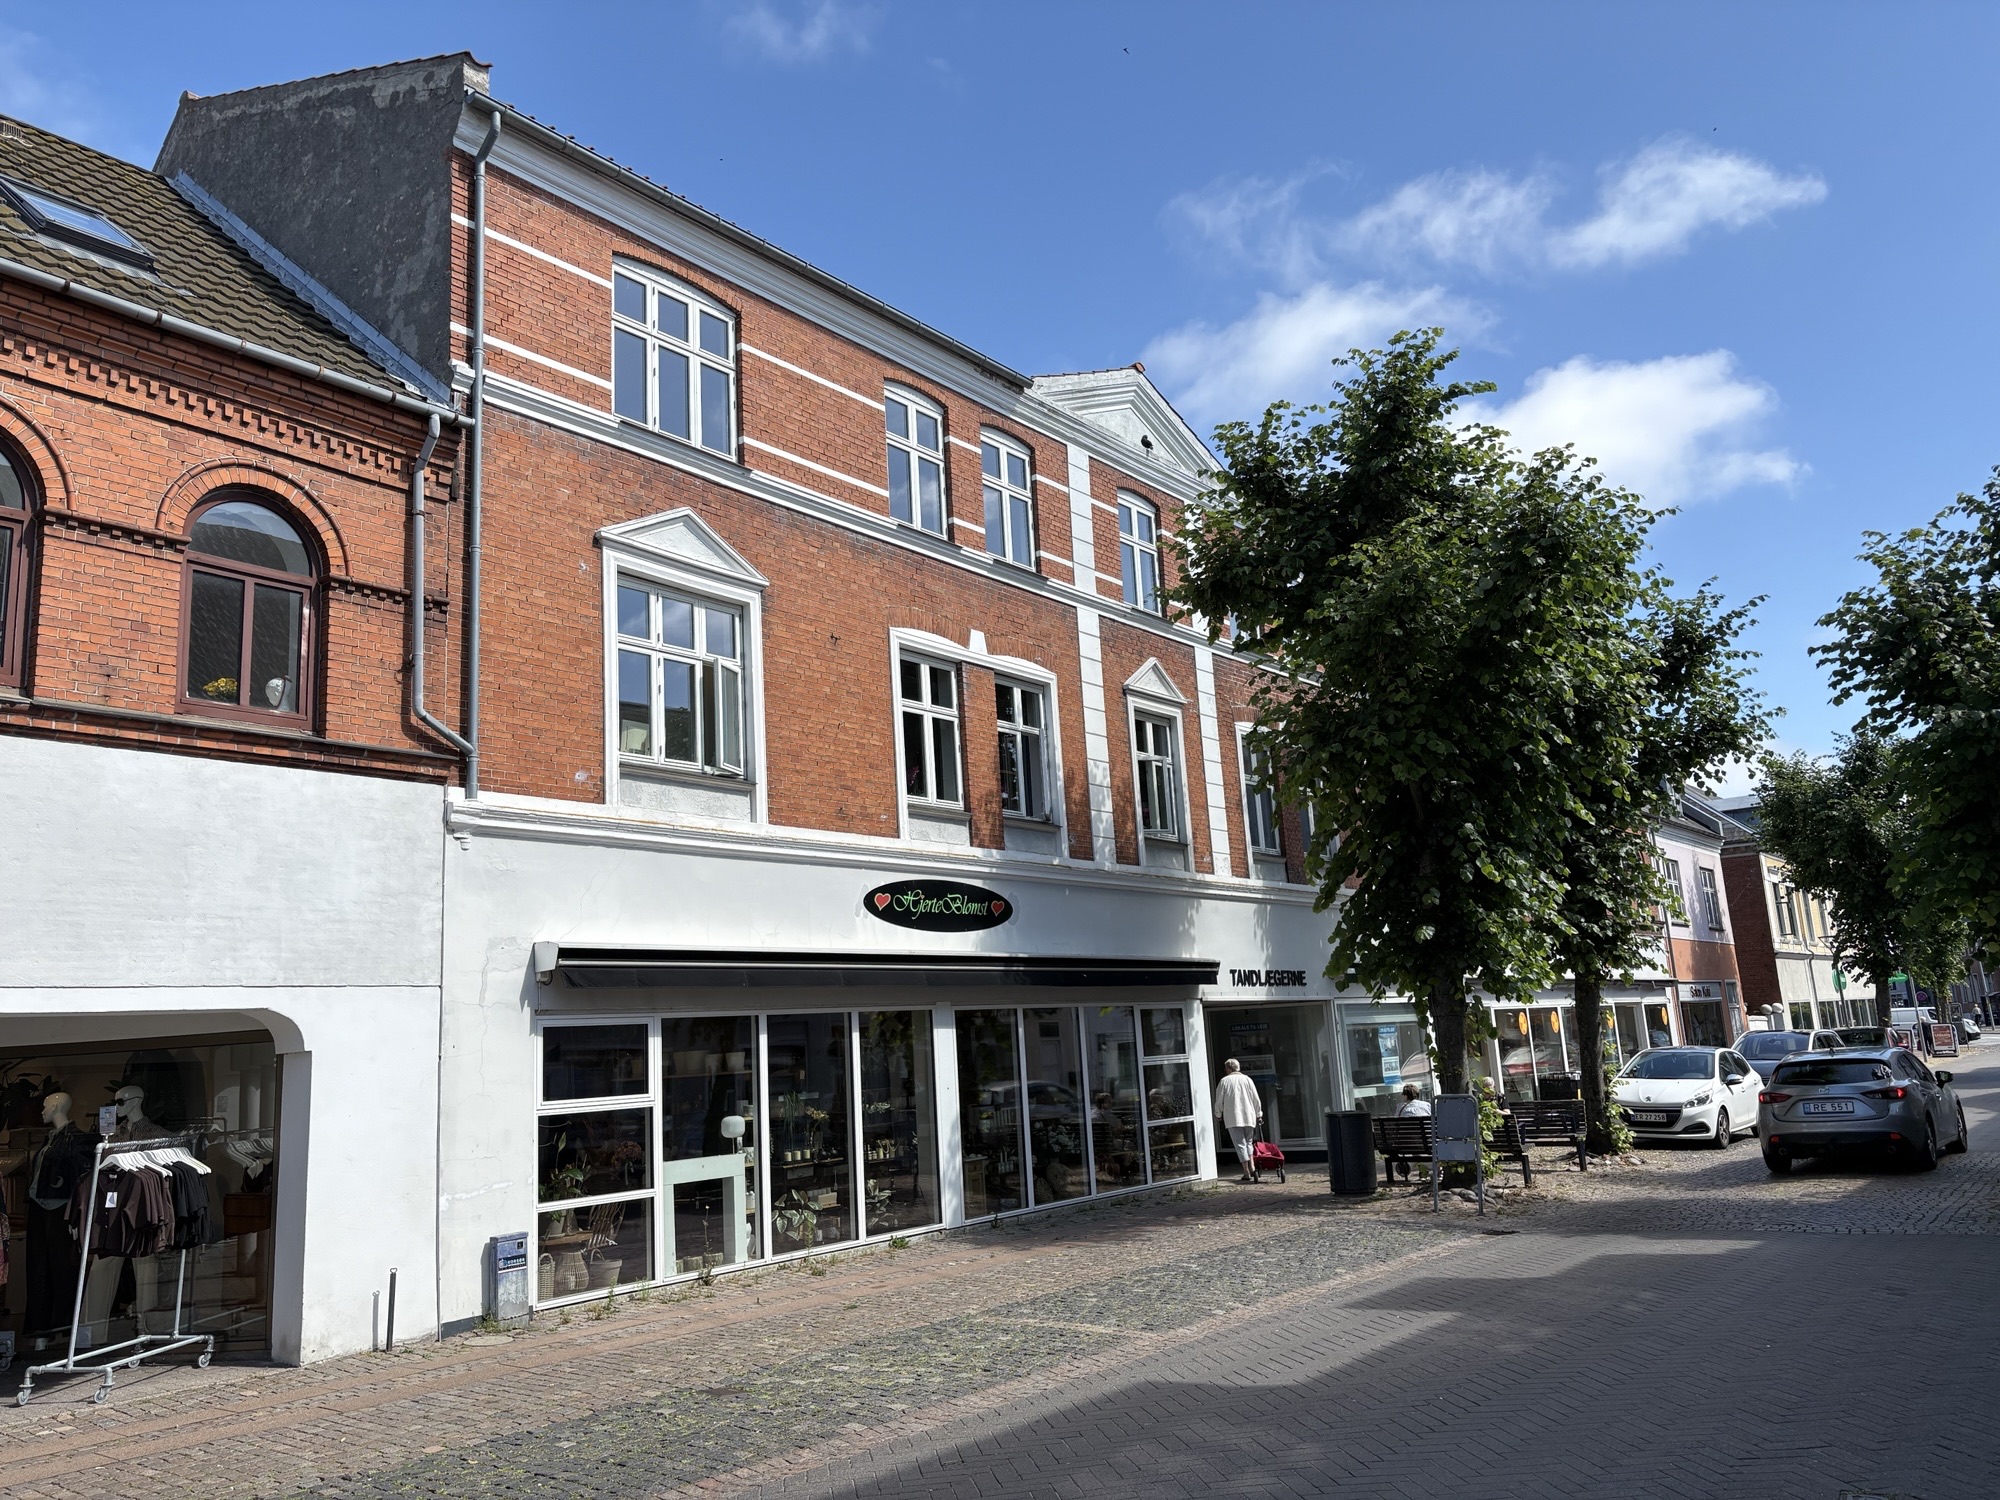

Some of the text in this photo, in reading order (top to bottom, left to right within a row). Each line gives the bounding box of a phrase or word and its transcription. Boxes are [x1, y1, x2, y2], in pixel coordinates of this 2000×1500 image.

[1229, 969, 1308, 987] TANDLÆGERNE
[1813, 1102, 1849, 1111] RE 551
